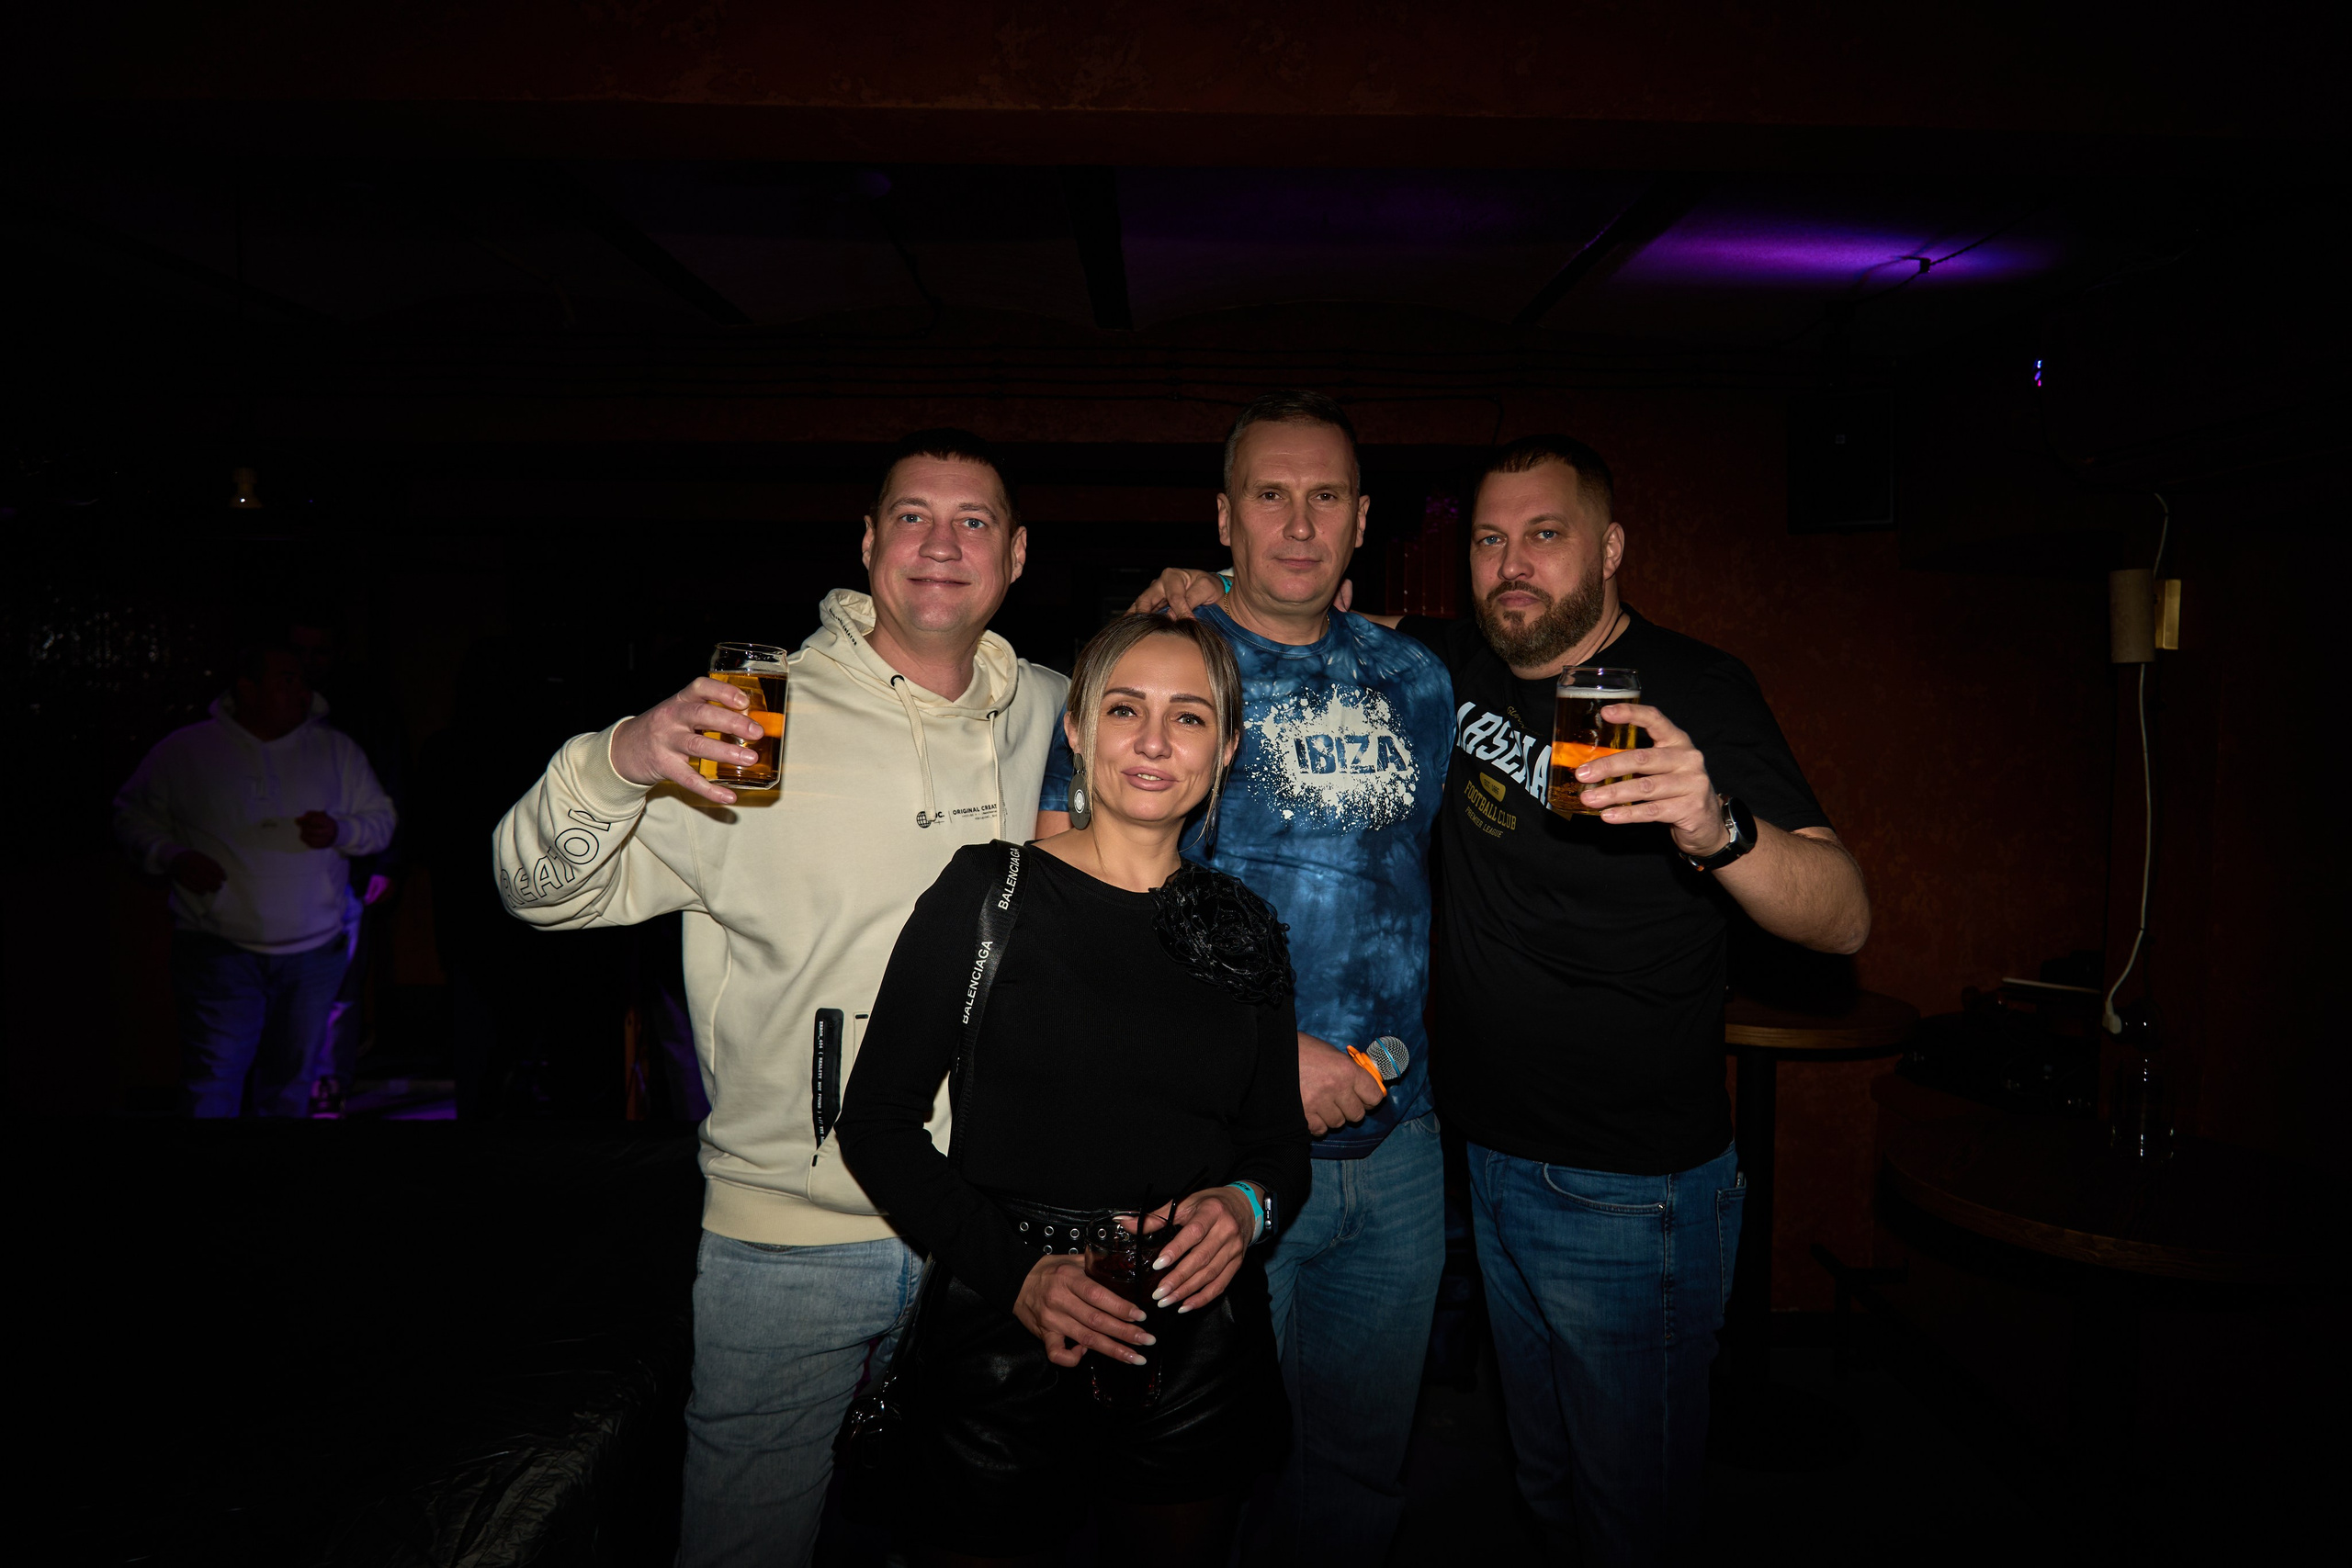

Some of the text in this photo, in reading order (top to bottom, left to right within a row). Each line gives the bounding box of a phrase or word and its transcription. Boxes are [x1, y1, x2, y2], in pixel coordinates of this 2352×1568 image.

[1294, 734, 1408, 774] IBIZA
[953, 807, 979, 816] ORIGINAL
[1464, 780, 1516, 830] FOOTBALL CLUB
[1464, 806, 1503, 838] PREMIER LEAGUE
[500, 808, 611, 908] REATOR
[998, 848, 1020, 910] BALENCIAGA
[962, 941, 993, 1024] BALENCIAGA
